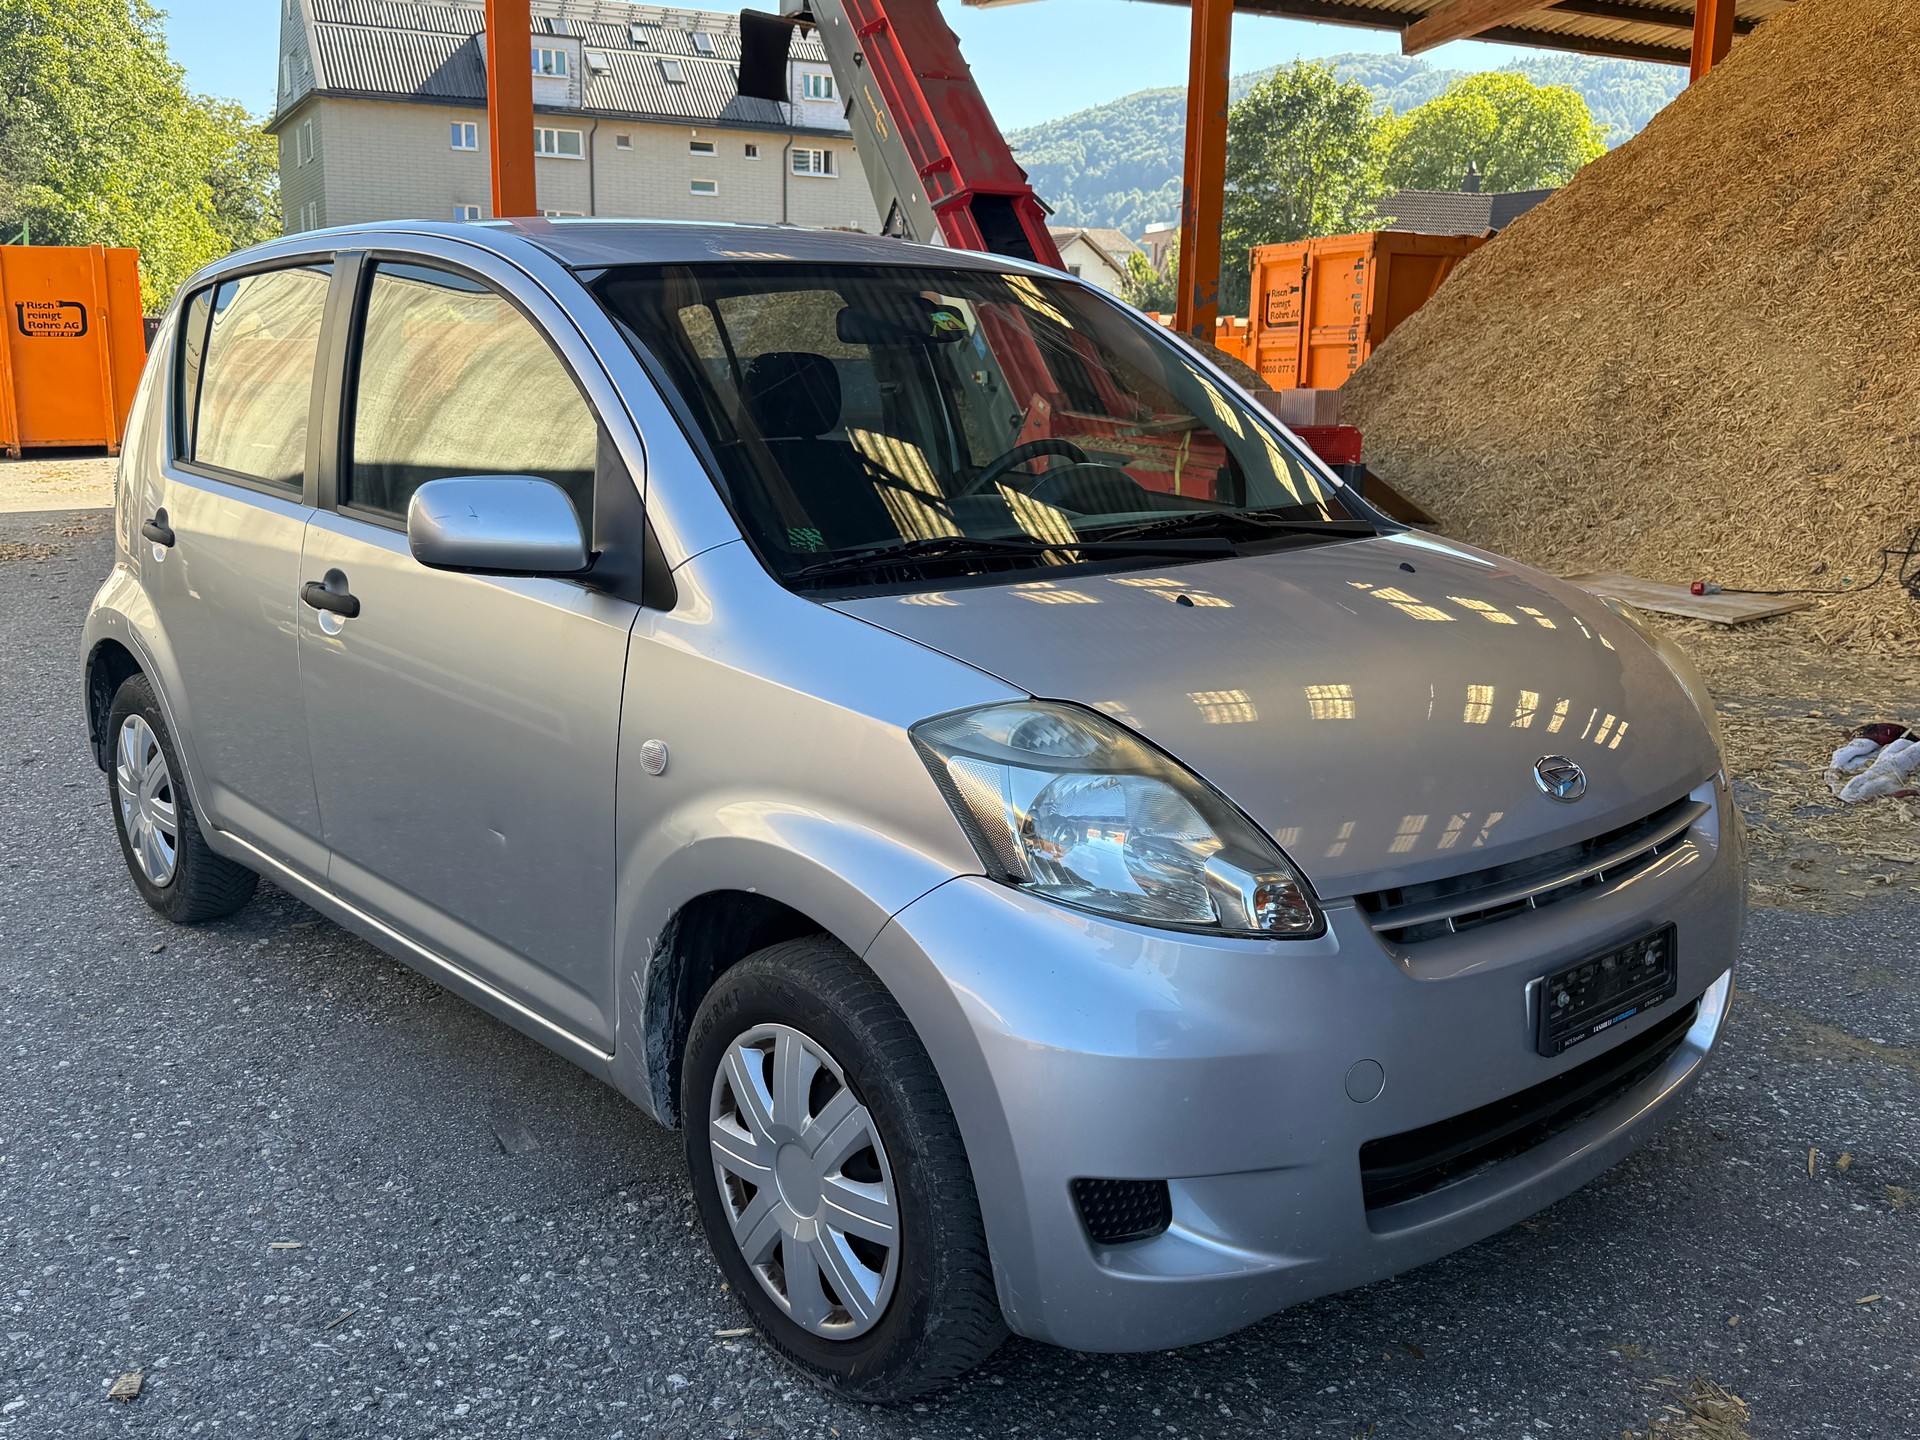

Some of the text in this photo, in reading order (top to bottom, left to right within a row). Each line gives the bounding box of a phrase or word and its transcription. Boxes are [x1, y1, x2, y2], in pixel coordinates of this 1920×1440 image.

[27, 301, 55, 310] Risch
[27, 311, 62, 321] reinigt
[1270, 311, 1290, 320] Rohre
[28, 321, 61, 329] Rohre
